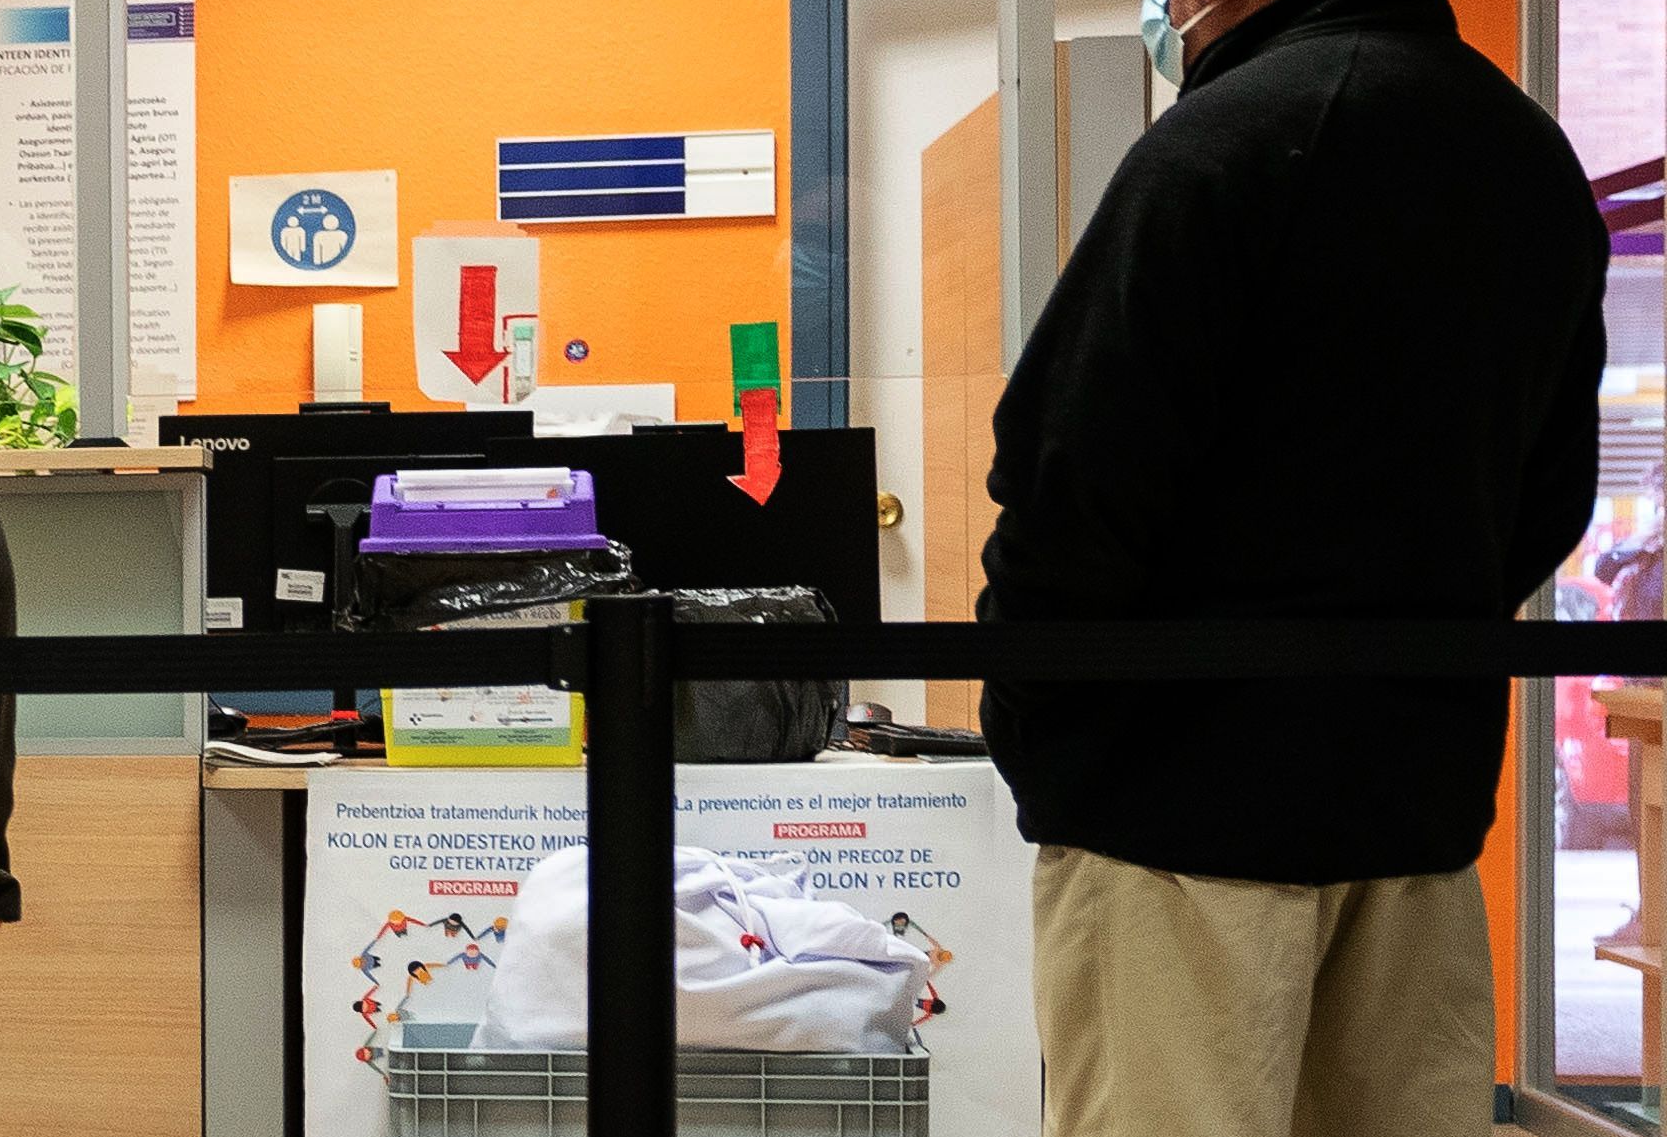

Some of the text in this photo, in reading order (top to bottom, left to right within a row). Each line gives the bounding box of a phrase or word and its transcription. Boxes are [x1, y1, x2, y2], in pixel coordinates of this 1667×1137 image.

[180, 435, 251, 451] Lenovo
[336, 802, 425, 820] Prebentzioa
[431, 804, 538, 821] tratamendurik
[675, 792, 967, 814] La prevención es el mejor tratamiento
[777, 823, 863, 838] PROGRAMA
[327, 832, 387, 849] KOLON
[394, 835, 422, 849] ETA
[427, 833, 535, 850] ONDESTEKO
[389, 855, 541, 872] GOIZ DETEKTATZE
[839, 849, 905, 864] PRECOZ
[910, 849, 933, 863] DE
[432, 880, 516, 896] PROGRAMA
[812, 871, 961, 889] OLON Y RECTO
